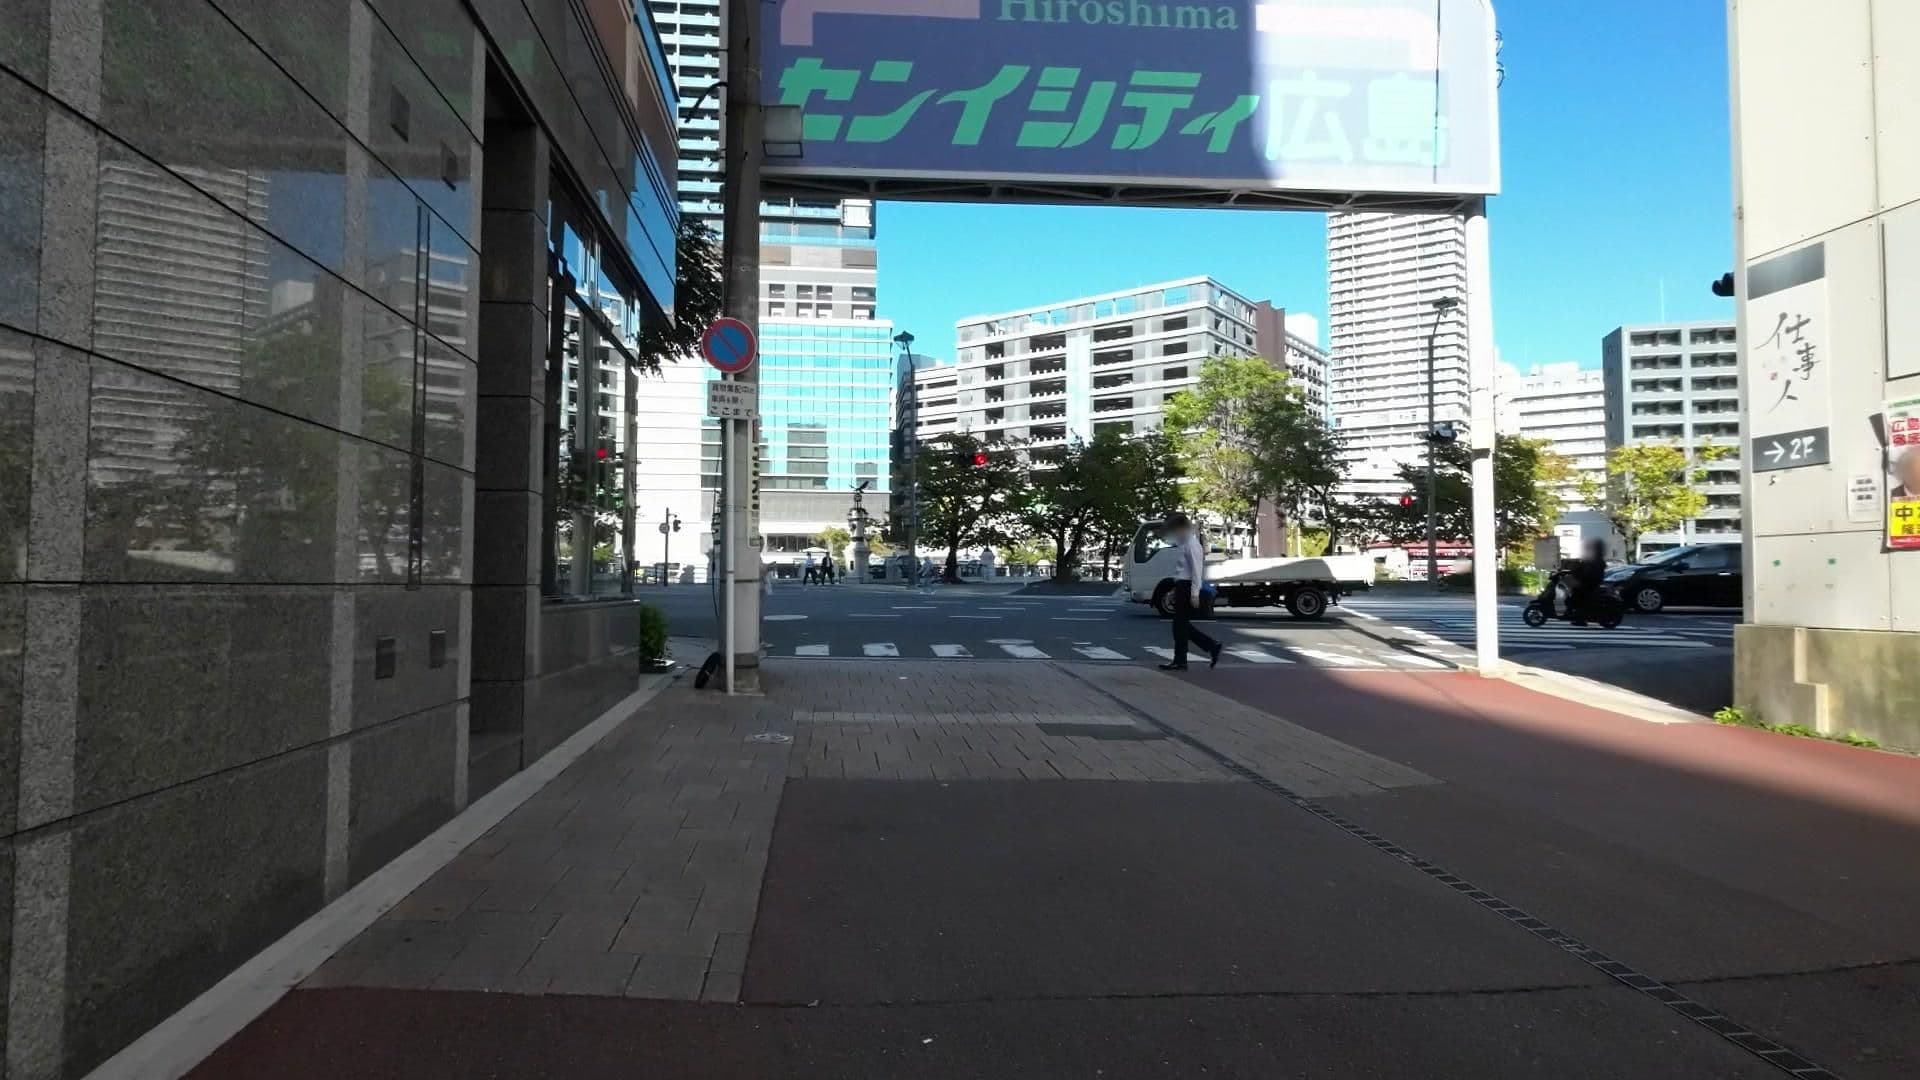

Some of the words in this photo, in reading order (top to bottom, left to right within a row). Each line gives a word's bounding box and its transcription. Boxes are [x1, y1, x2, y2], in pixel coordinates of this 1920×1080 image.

[996, 0, 1239, 30] Hiroshima
[779, 57, 1448, 167] センイシティ広島
[1754, 312, 1822, 413] 仕事人
[711, 406, 753, 416] ここまで
[1790, 434, 1816, 460] 2F
